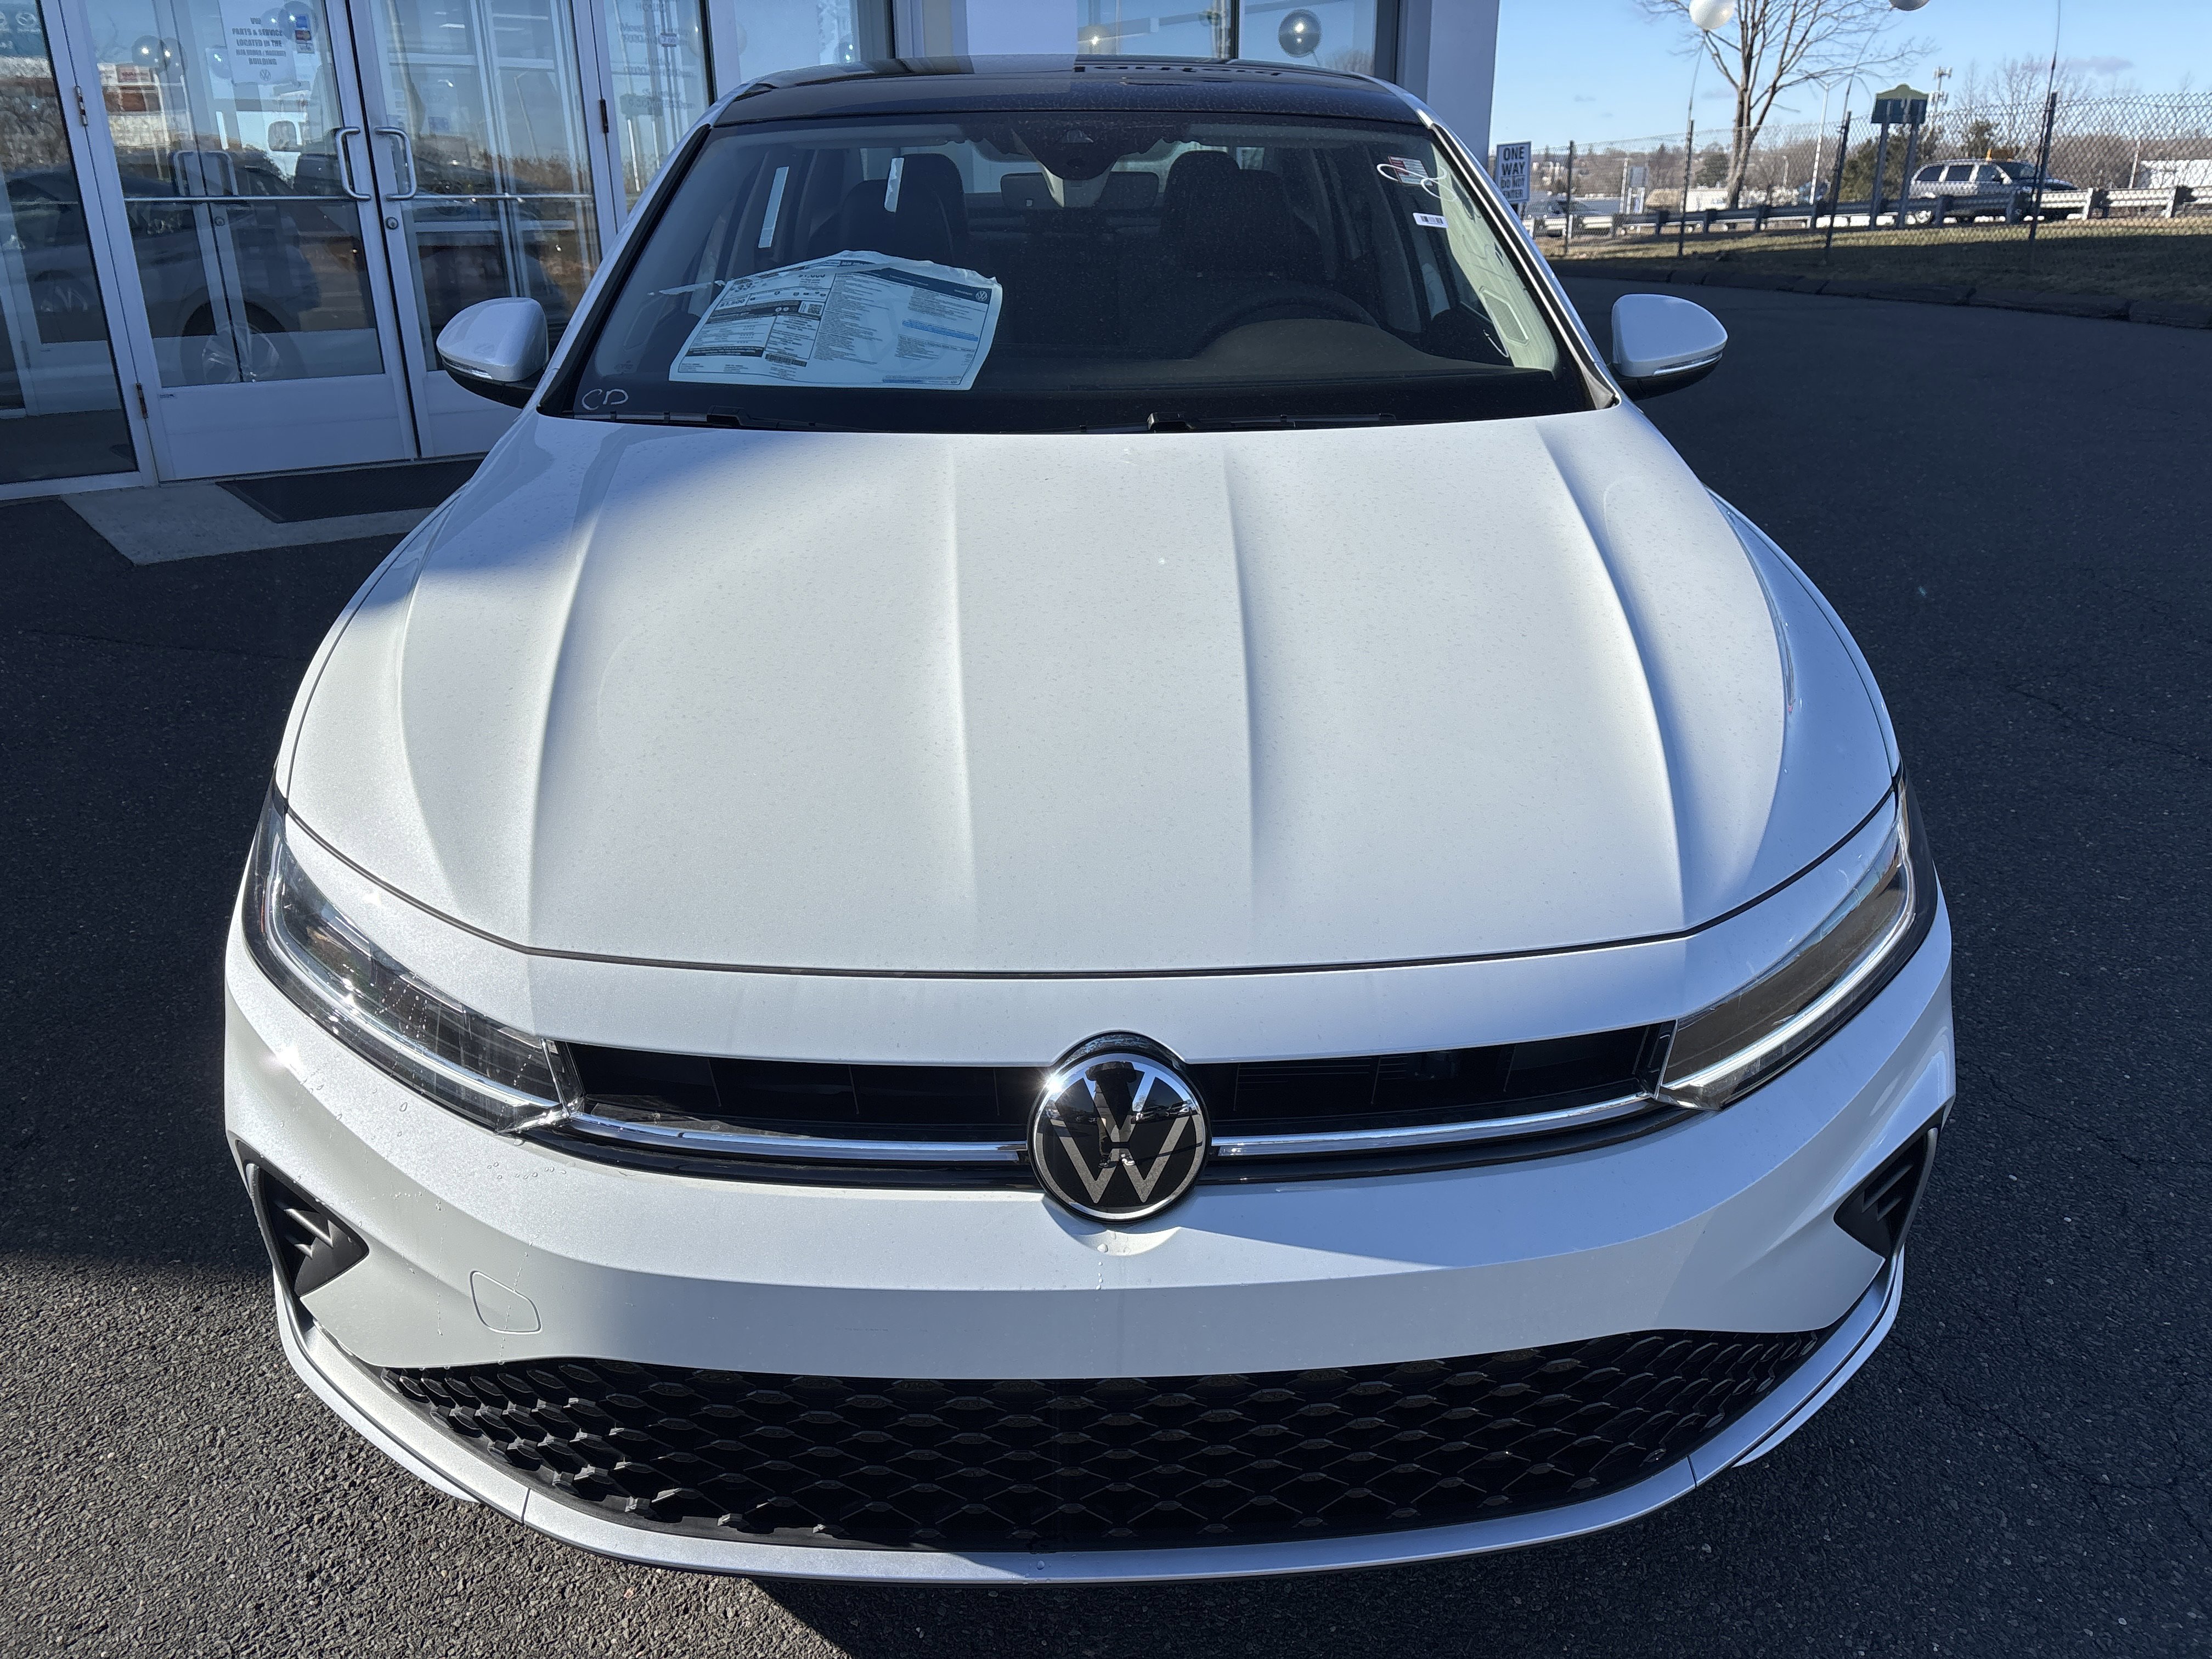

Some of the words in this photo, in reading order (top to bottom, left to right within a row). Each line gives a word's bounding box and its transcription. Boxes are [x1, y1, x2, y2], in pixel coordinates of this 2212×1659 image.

[1504, 146, 1524, 160] ONE
[1501, 161, 1525, 176] WAY
[1500, 178, 1511, 188] DO
[1513, 177, 1525, 187] NOT
